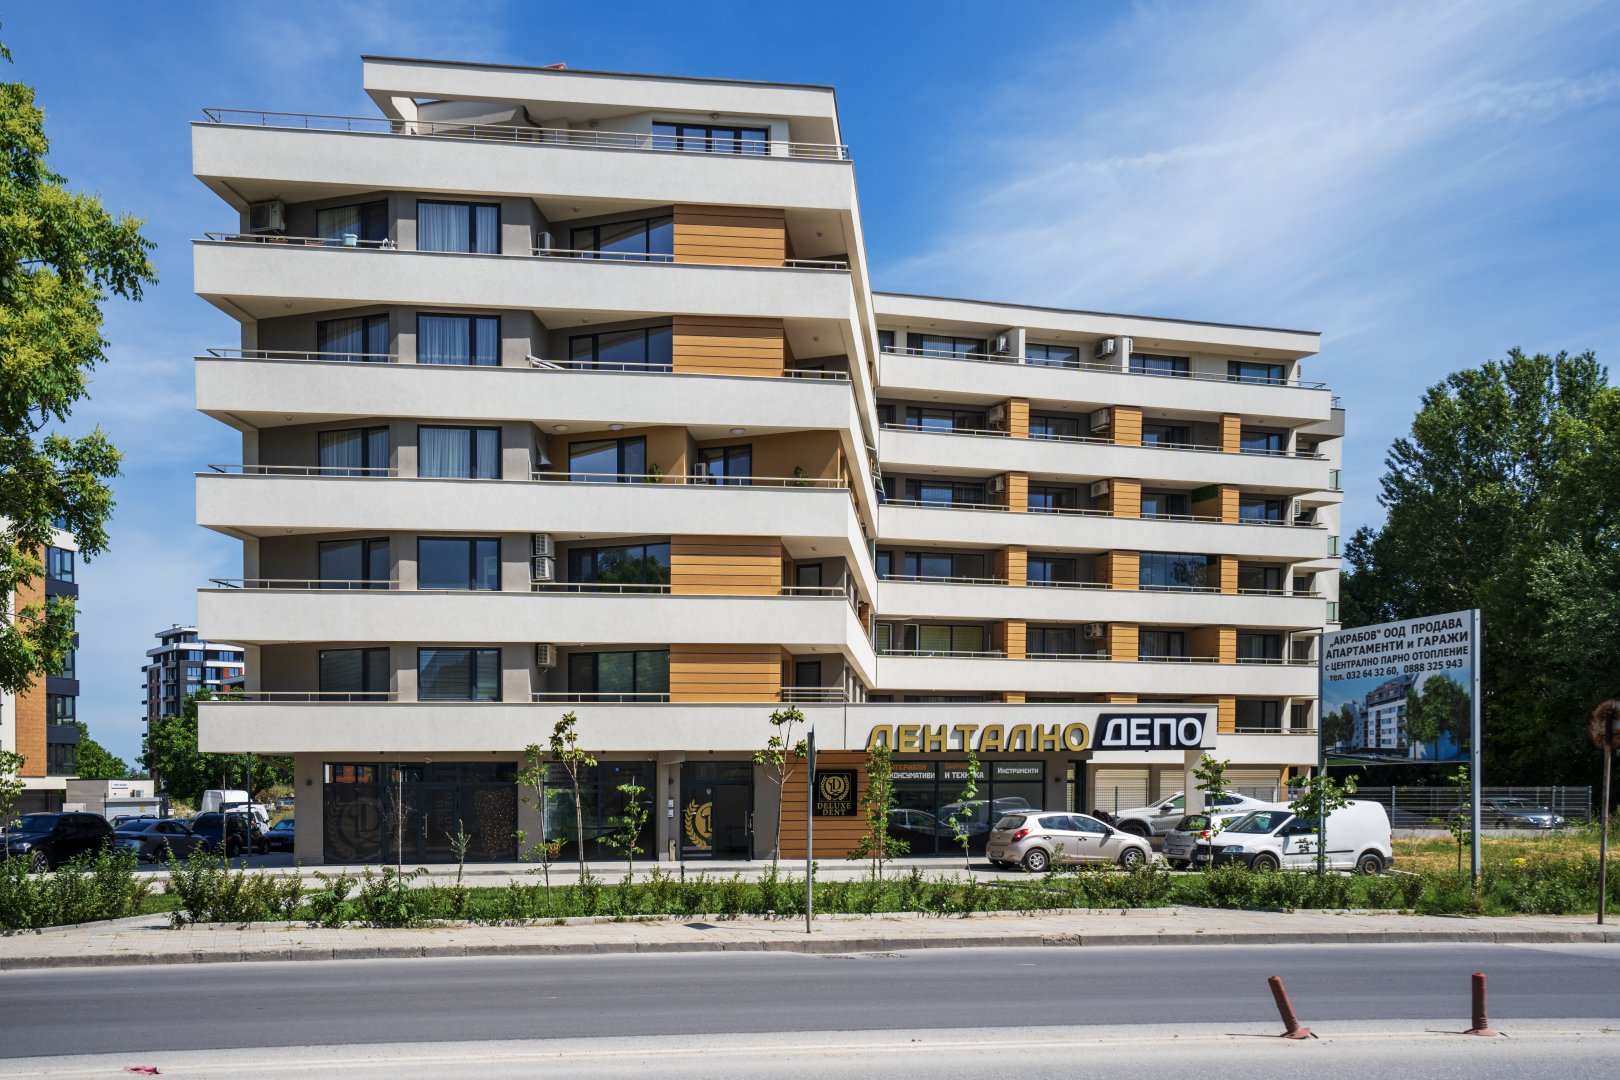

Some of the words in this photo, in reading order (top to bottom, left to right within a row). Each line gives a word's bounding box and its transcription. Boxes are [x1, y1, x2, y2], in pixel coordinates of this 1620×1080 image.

[1384, 626, 1406, 638] ООД
[1411, 618, 1463, 635] ПРОДАВА
[1325, 639, 1404, 660] АПАРТАМЕНТИ
[1407, 641, 1414, 649] и
[1417, 631, 1468, 648] ГАРАЖИ
[1329, 674, 1344, 682] тел.
[1346, 671, 1361, 680] 032
[1362, 669, 1373, 679] 64
[1374, 668, 1385, 677] 32
[1386, 666, 1399, 677] 60,
[1403, 663, 1425, 674] 0888
[1427, 661, 1444, 671] 325
[1445, 659, 1463, 669] 943
[1330, 656, 1379, 672] ЦЕНТРАЛНО
[1380, 652, 1410, 665] ПАРНО
[1412, 646, 1469, 661] ОТОПЛЕНИЕ
[866, 722, 1090, 753] ДЕНТАЛНО
[1101, 717, 1202, 746] ДЕПО
[817, 802, 852, 810] DELUXE
